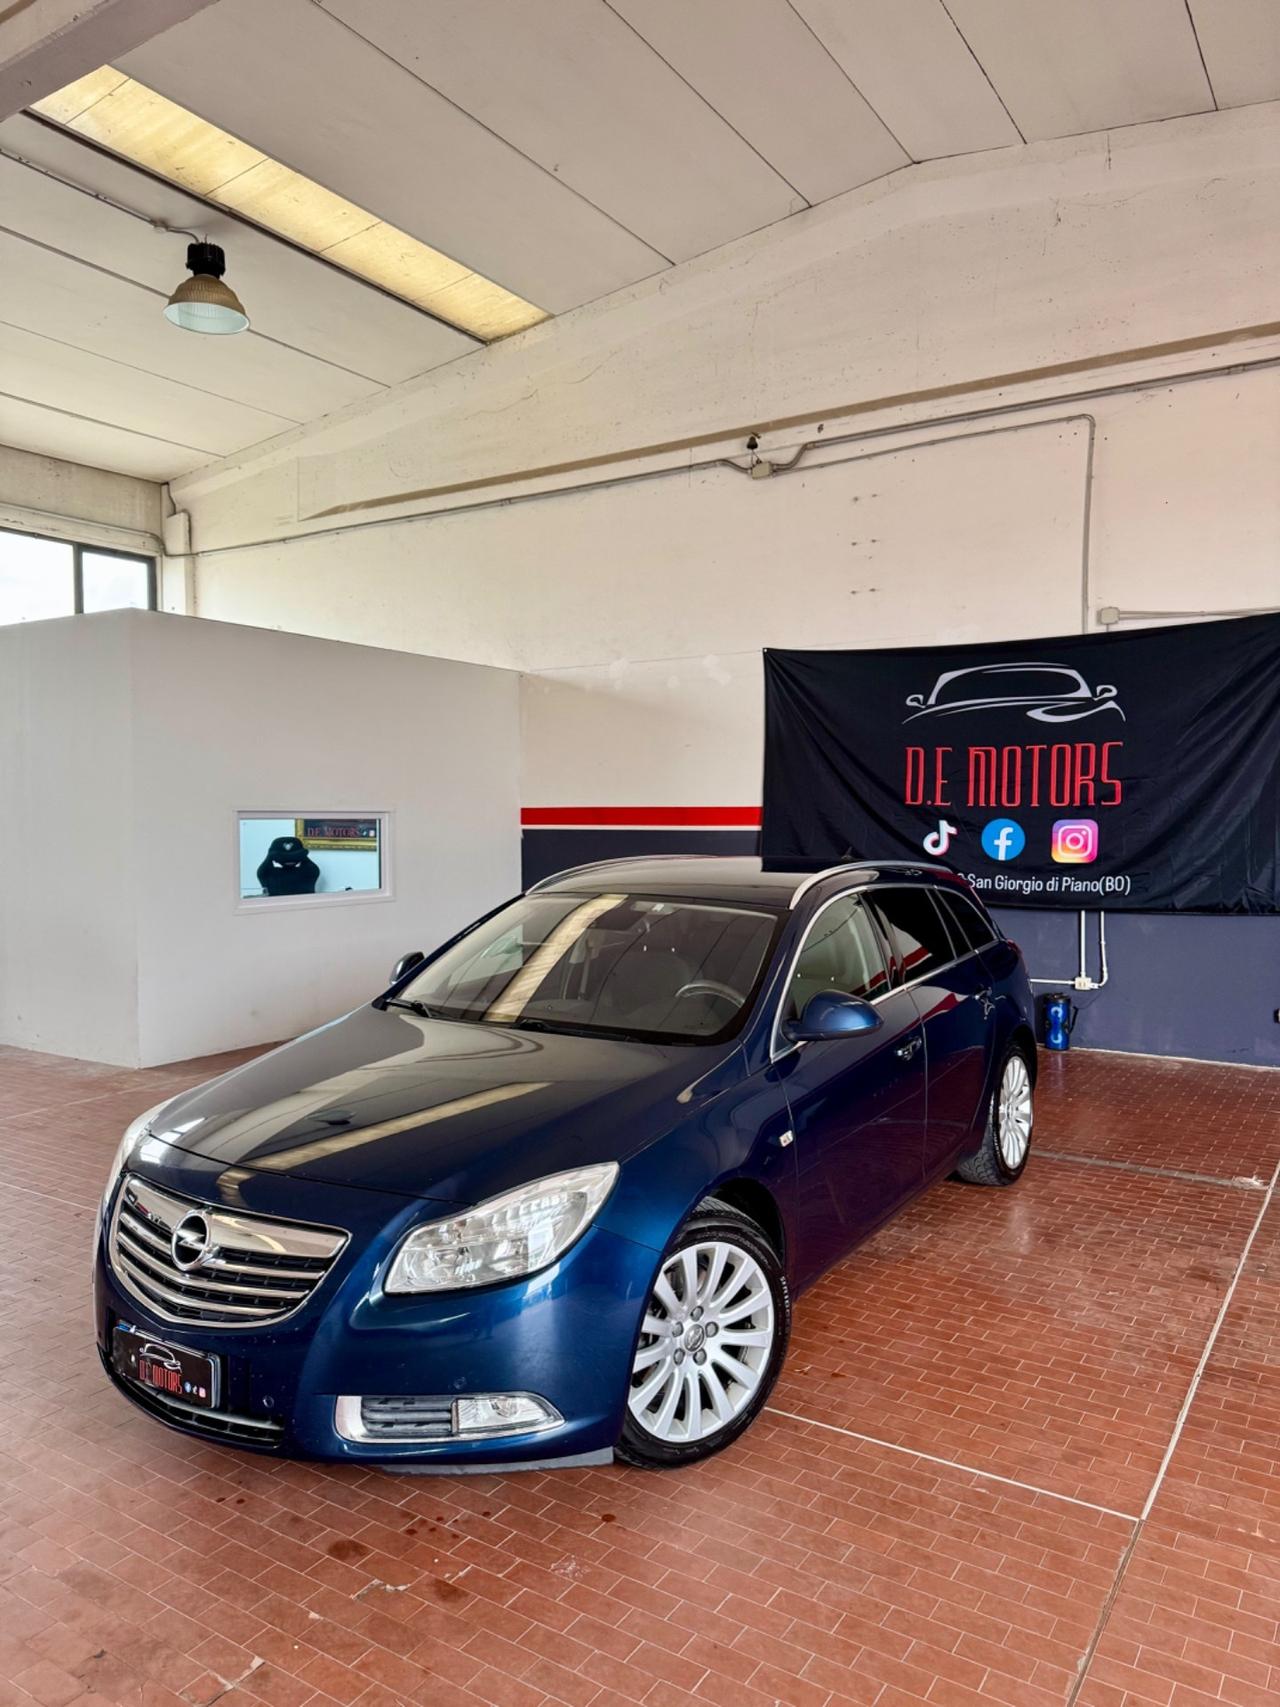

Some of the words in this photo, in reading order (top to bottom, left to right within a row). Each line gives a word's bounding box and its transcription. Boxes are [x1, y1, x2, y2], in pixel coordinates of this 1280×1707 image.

[905, 746, 953, 806] D.E
[967, 741, 1124, 807] MOTORS
[967, 873, 992, 889] San
[994, 875, 1043, 894] Giorgio
[1046, 876, 1059, 892] di
[1061, 876, 1131, 895] Piano(BO)
[152, 1363, 183, 1394] MOTORS
